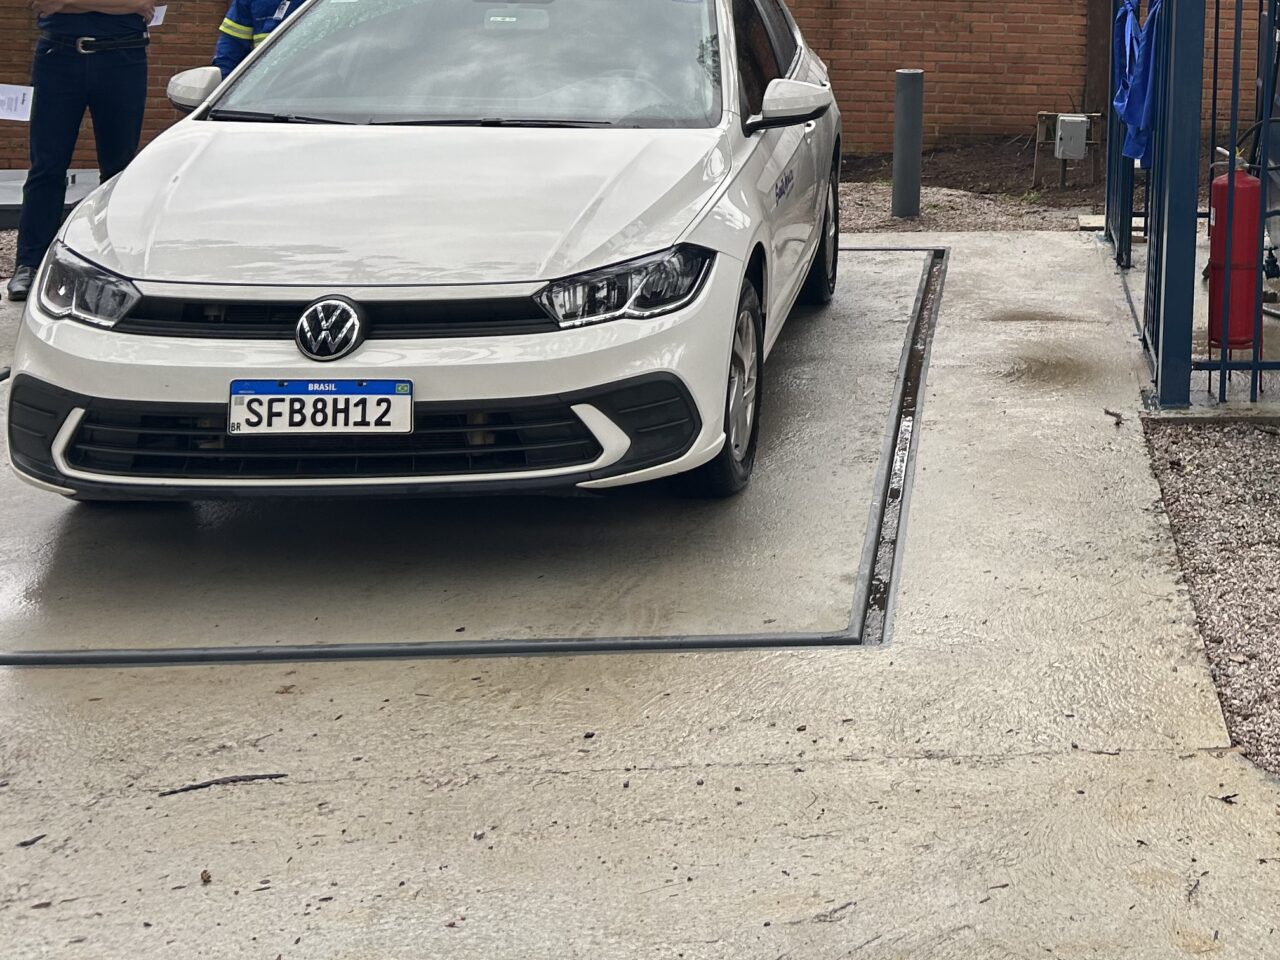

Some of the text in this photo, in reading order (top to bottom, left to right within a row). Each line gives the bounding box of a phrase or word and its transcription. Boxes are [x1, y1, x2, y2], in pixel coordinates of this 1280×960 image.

[308, 383, 337, 391] BRASIL
[245, 397, 392, 428] SFB8H12
[230, 422, 242, 432] BR
